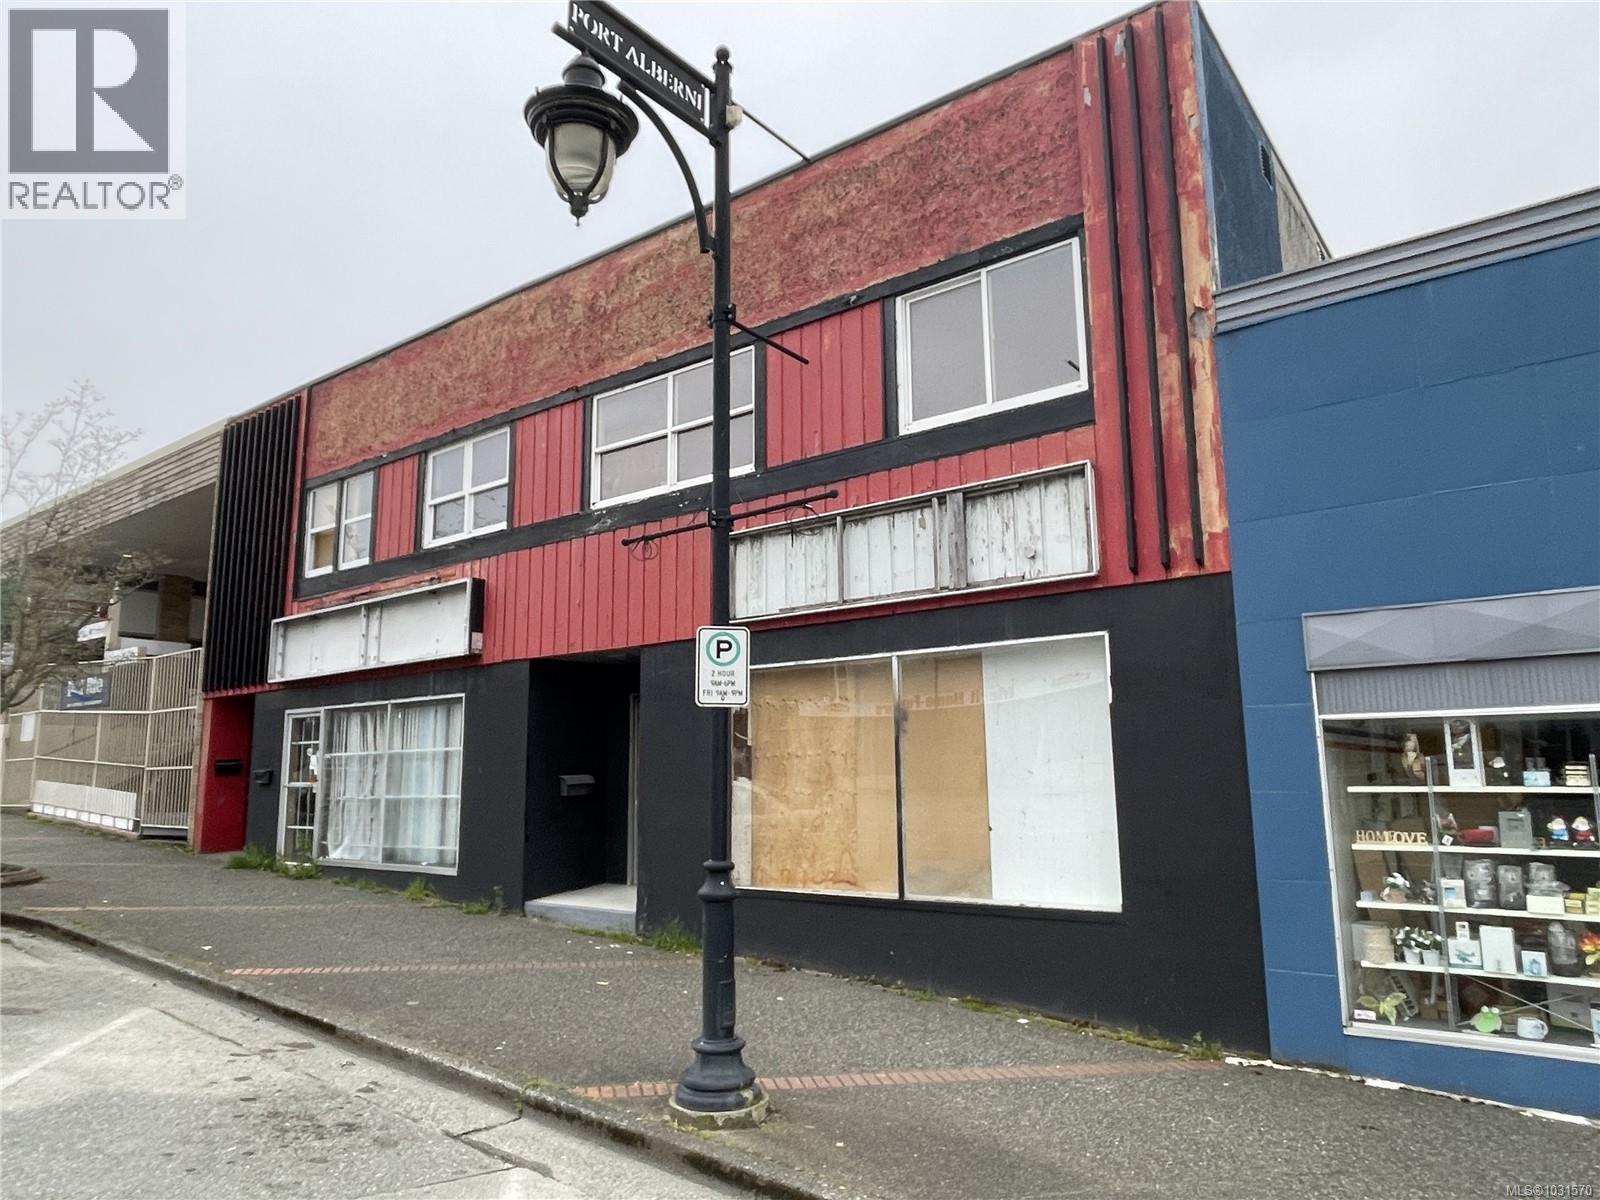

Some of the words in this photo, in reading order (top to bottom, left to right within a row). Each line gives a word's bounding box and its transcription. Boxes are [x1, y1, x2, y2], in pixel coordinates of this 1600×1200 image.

[571, 3, 623, 53] PORT
[625, 46, 702, 111] ALBERNI
[716, 640, 732, 659] P
